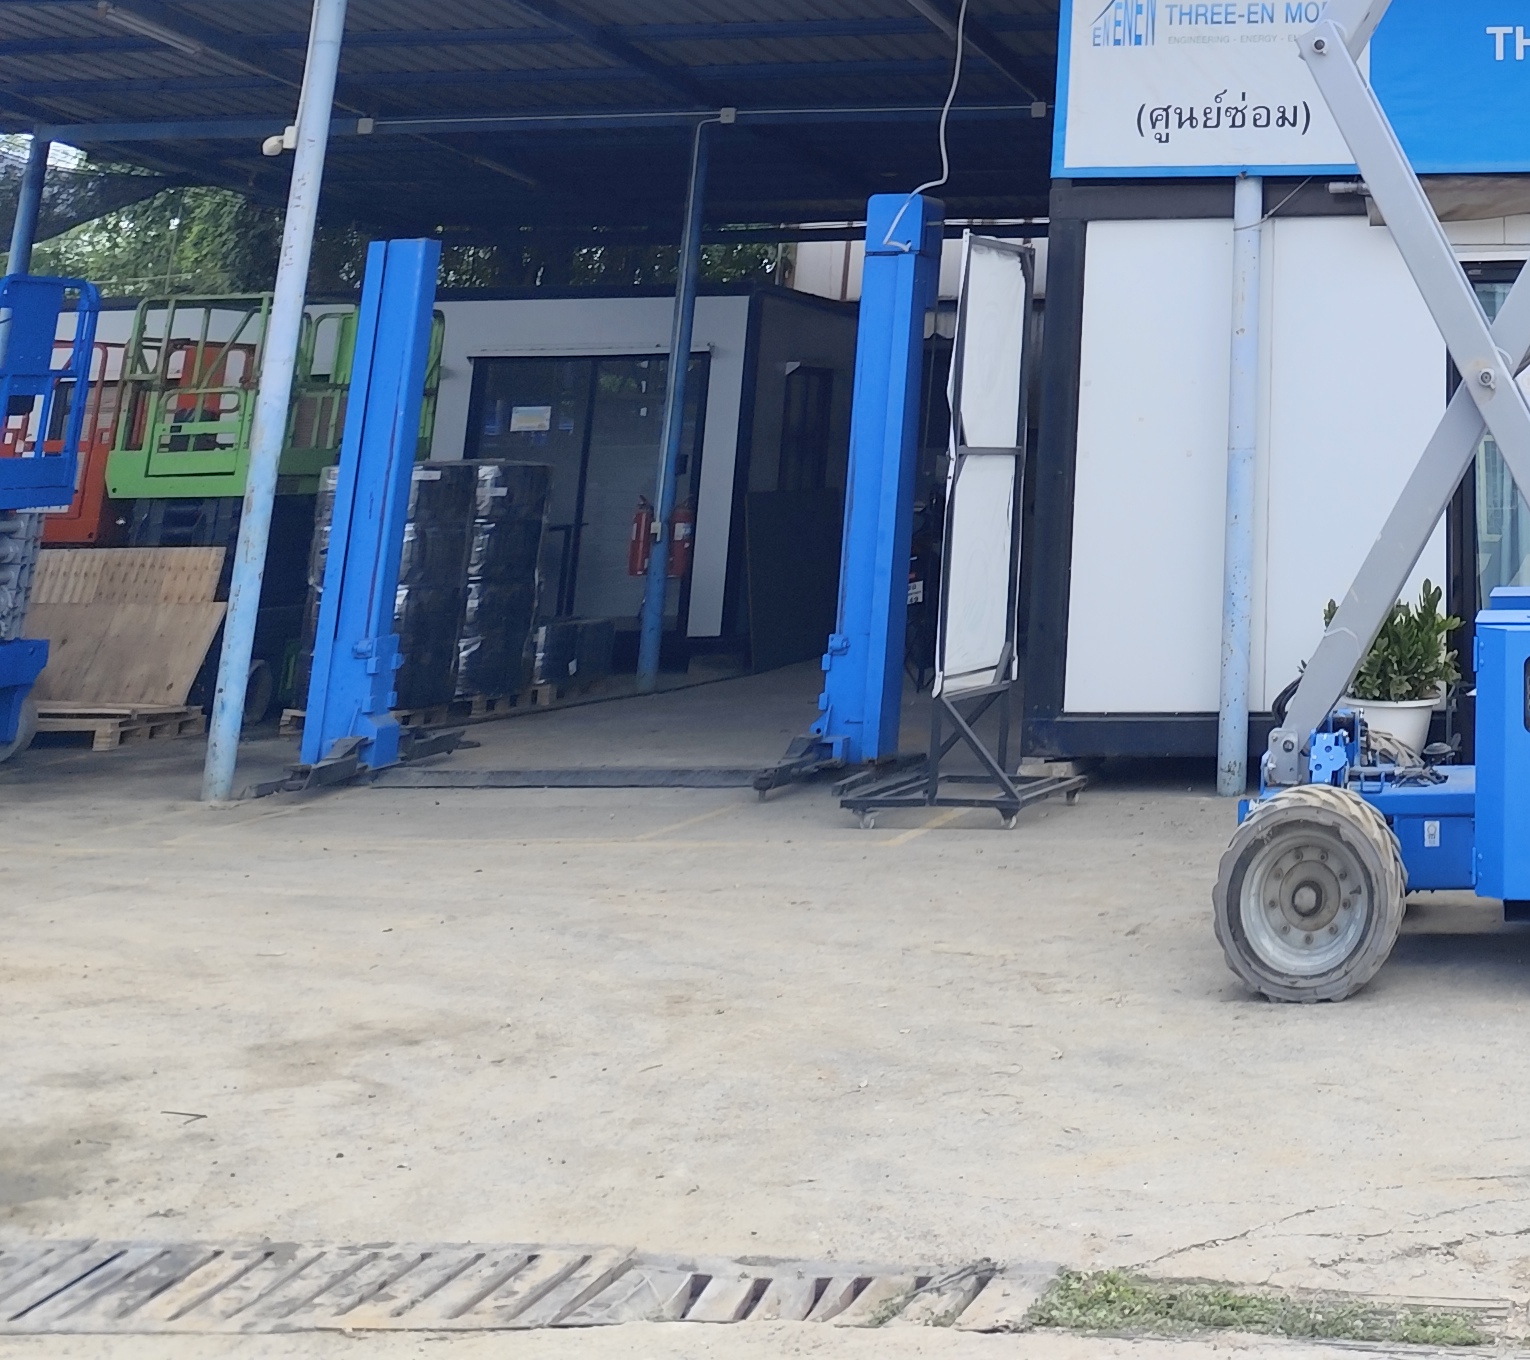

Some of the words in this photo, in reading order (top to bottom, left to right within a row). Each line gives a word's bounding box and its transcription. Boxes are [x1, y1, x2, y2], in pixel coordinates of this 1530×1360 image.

[1165, 1, 1275, 26] THREE-EN
[1284, 0, 1328, 24] MO
[1167, 35, 1230, 45] ENGINEERING
[1240, 34, 1278, 43] ENERGY
[1136, 89, 1311, 144] (ศูนย์ซ่อม)
